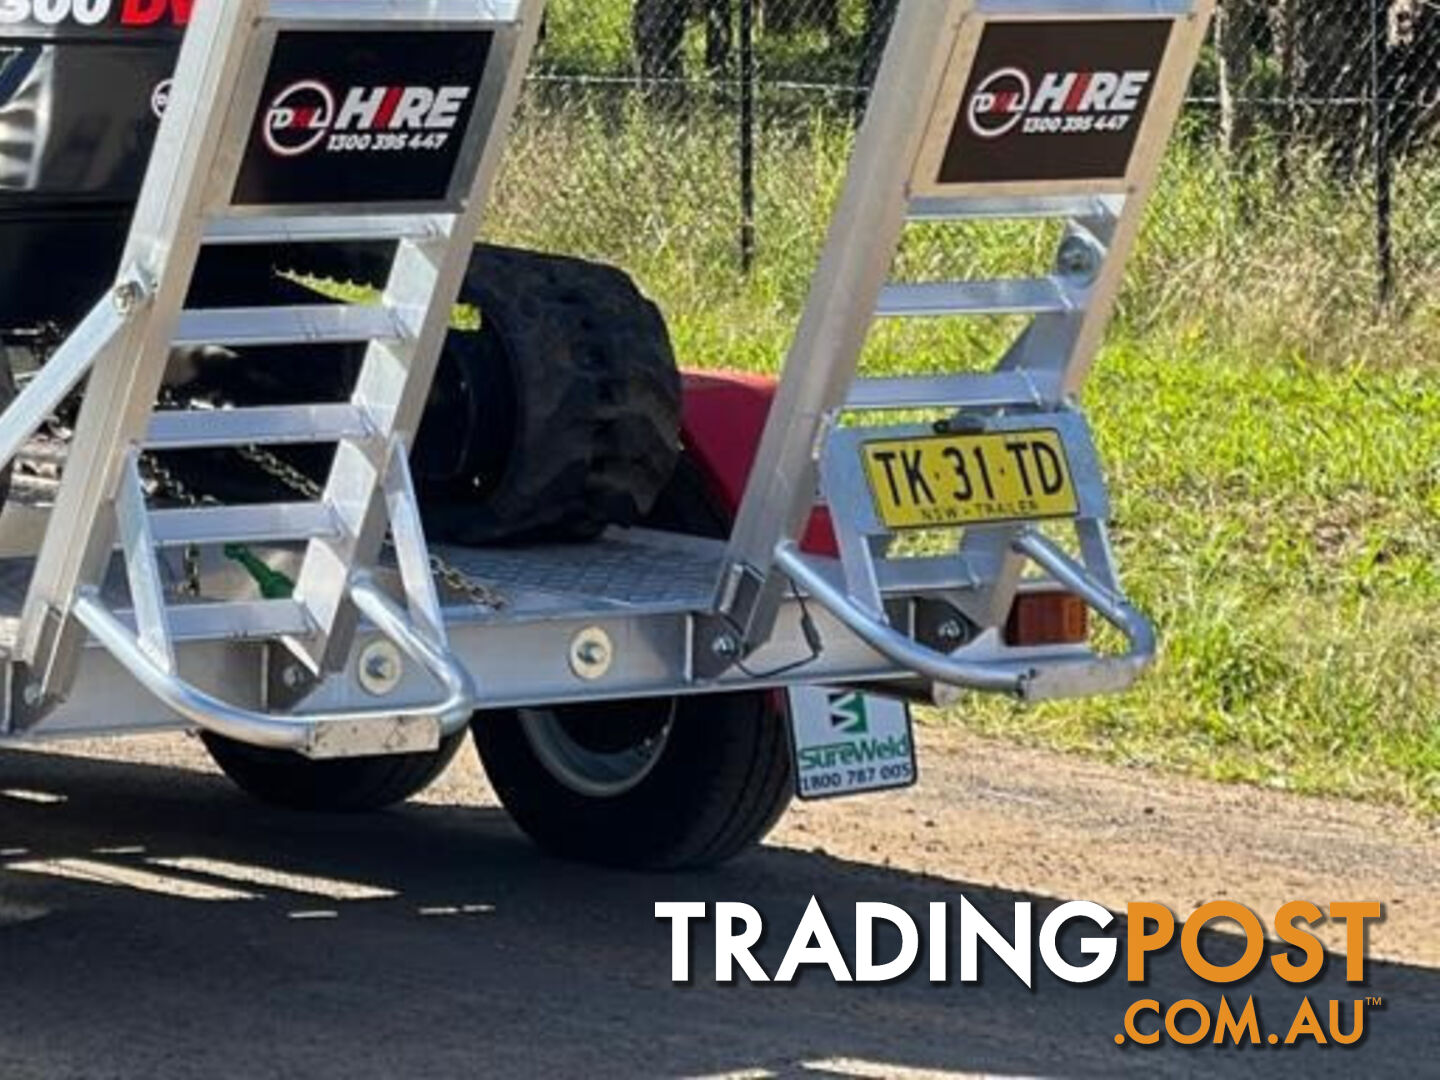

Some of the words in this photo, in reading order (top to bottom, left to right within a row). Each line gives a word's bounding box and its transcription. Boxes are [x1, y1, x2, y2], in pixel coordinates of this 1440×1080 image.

[334, 86, 470, 130] HIRE
[1030, 71, 1150, 113] HIRE
[1022, 116, 1061, 133] 1300
[1093, 114, 1130, 131] 447
[326, 133, 370, 151] 1300
[408, 132, 449, 150] 447
[799, 734, 907, 770] SureWeld
[803, 773, 842, 791] 1800
[846, 767, 877, 783] 787
[879, 762, 911, 780] 005
